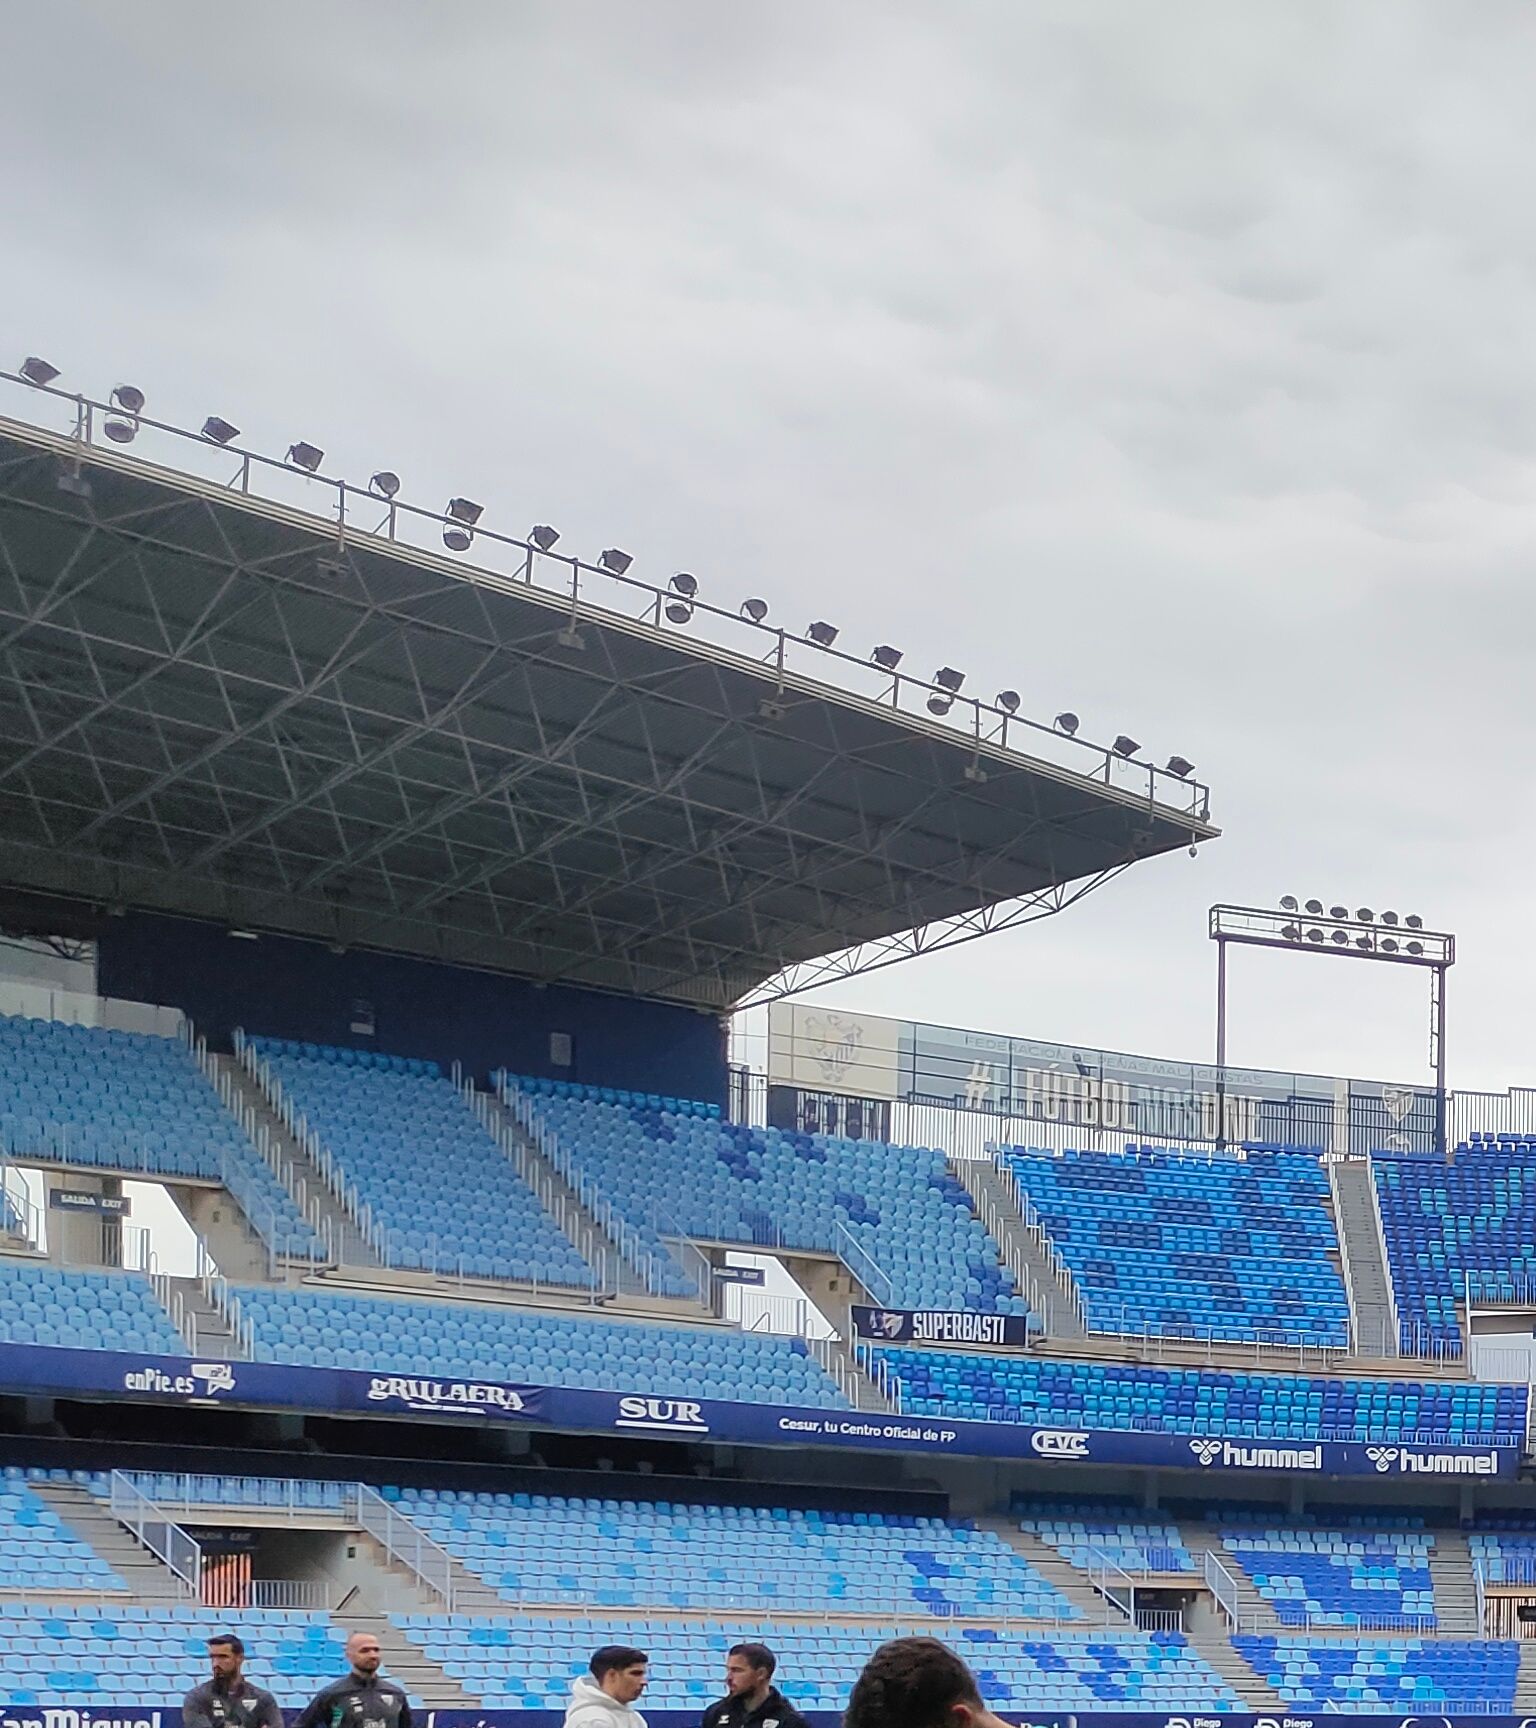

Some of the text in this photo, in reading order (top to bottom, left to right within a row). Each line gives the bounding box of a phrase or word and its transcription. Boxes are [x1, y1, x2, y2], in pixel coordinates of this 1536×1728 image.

[60, 1194, 122, 1210] SALIDA EXIT
[911, 1312, 1006, 1344] SUPERBASTI
[124, 1367, 195, 1394] enPie.es
[617, 1395, 705, 1423] SUR
[779, 1416, 956, 1443] Cesur, tu Centro Oficial de FP
[1223, 1445, 1323, 1470] hummel
[1400, 1450, 1498, 1475] hummel
